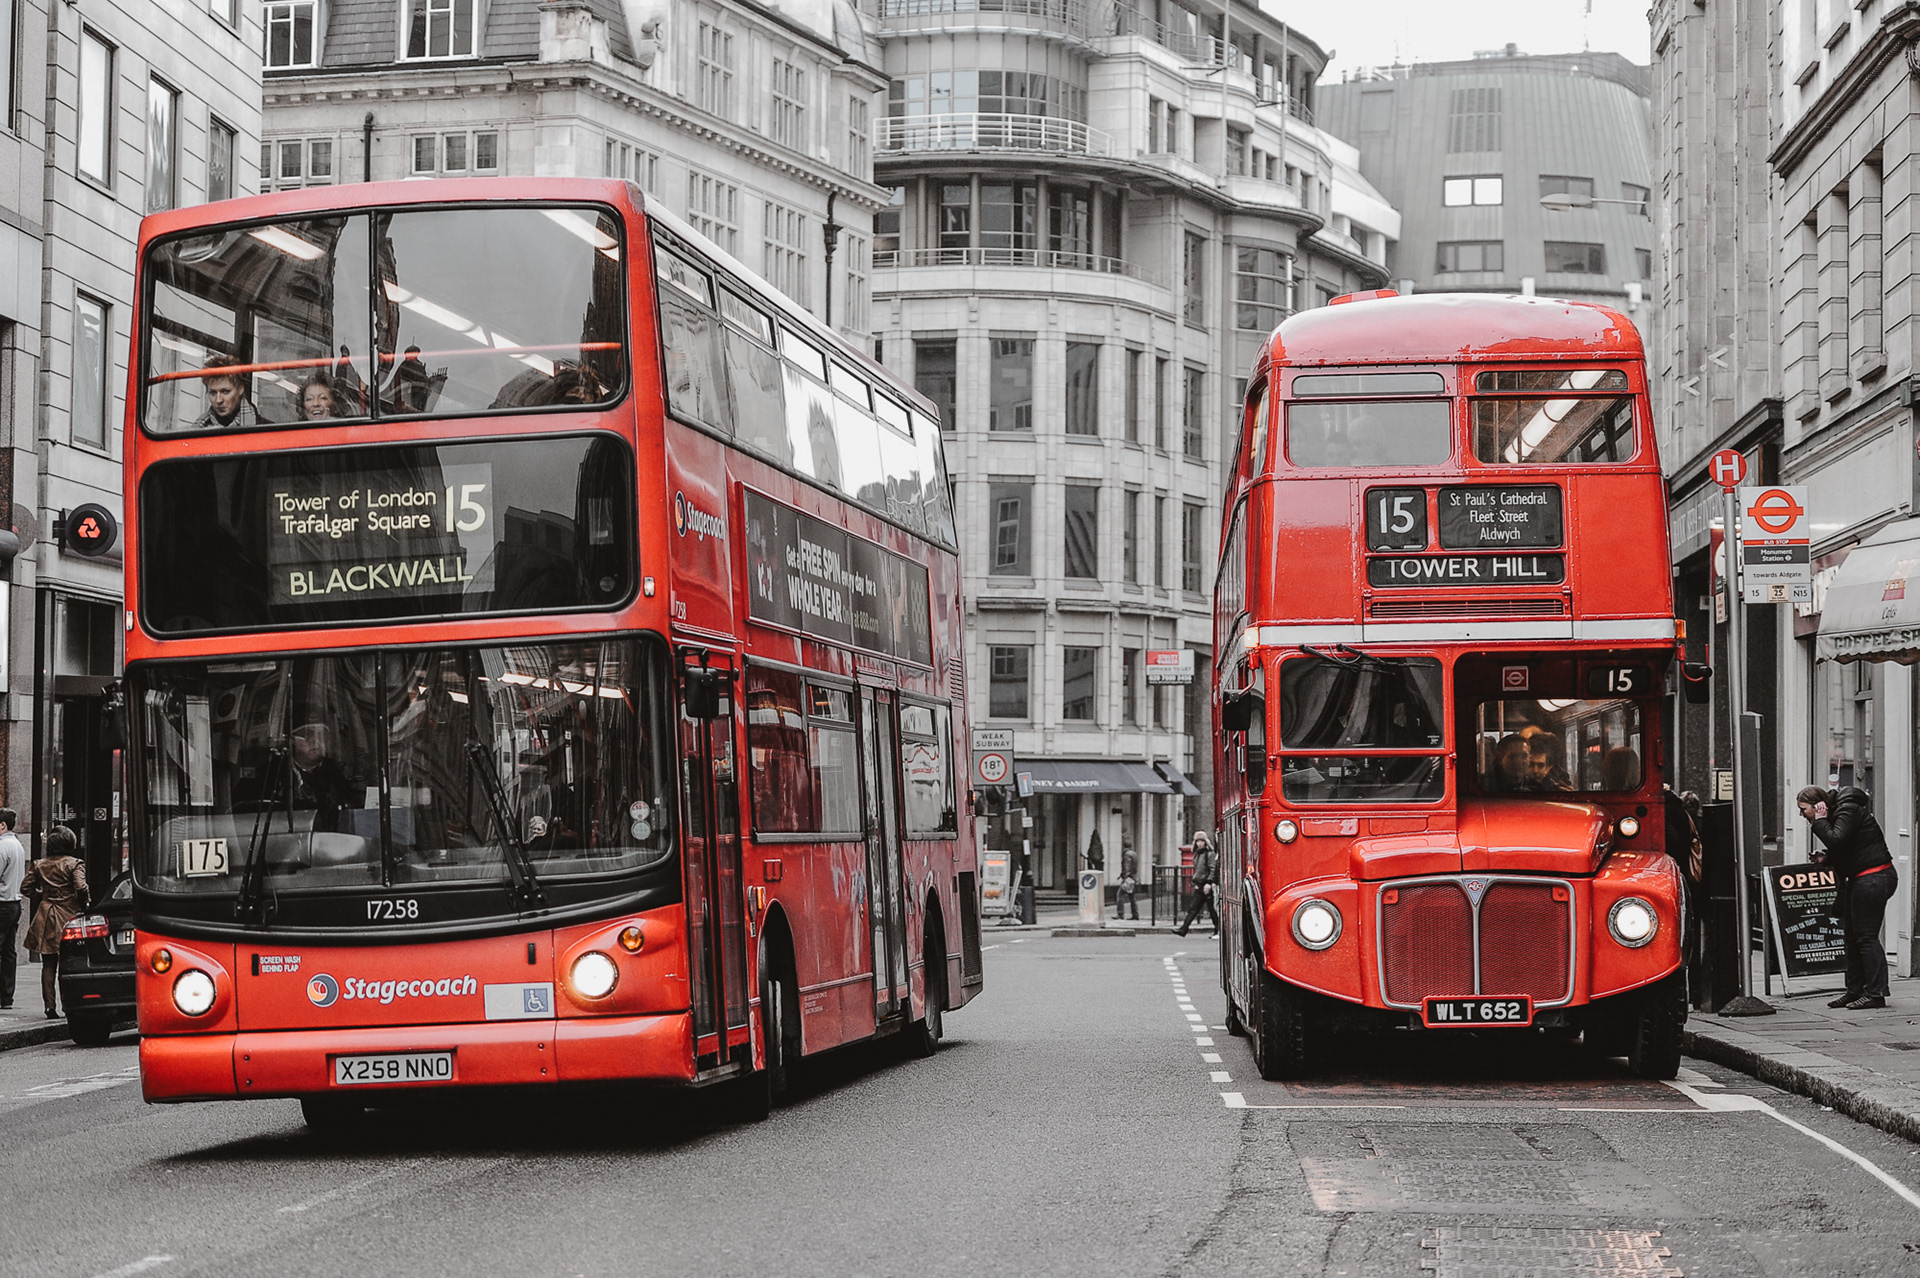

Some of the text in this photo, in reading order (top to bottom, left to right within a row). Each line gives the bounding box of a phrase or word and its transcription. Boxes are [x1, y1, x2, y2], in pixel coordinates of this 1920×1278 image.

[1715, 454, 1740, 482] H
[275, 487, 436, 512] Tower of London
[445, 483, 486, 533] 15
[1450, 491, 1548, 506] St Paul's Cathedral
[280, 511, 431, 539] Trafalgar Square
[687, 501, 726, 541] Stagecoach
[1379, 496, 1415, 534] 15
[1469, 510, 1529, 523] Fleet Street
[1480, 526, 1521, 543] Aldwych
[290, 556, 473, 596] BLACKWALL
[785, 544, 796, 568] Get
[801, 538, 823, 578] FREE
[823, 547, 841, 584] SPIN
[854, 571, 865, 597] day
[1385, 556, 1547, 579] TOWER HILL
[787, 574, 821, 617] WHOLE
[820, 585, 843, 623] YEAR
[854, 610, 860, 628] at
[859, 610, 880, 634] 888.com
[1834, 632, 1892, 650] COFFEE
[1608, 669, 1633, 692] 15
[189, 841, 225, 870] 175
[1779, 870, 1836, 889] OPEN
[1807, 891, 1838, 899] BREAKFAS
[367, 899, 419, 919] 17258
[260, 955, 301, 964] SCREEN WASH
[262, 964, 299, 972] BEHIND FLAP
[343, 974, 477, 1005] Stagecoach
[1436, 1002, 1521, 1021] WLT 652
[341, 1059, 400, 1080] X258
